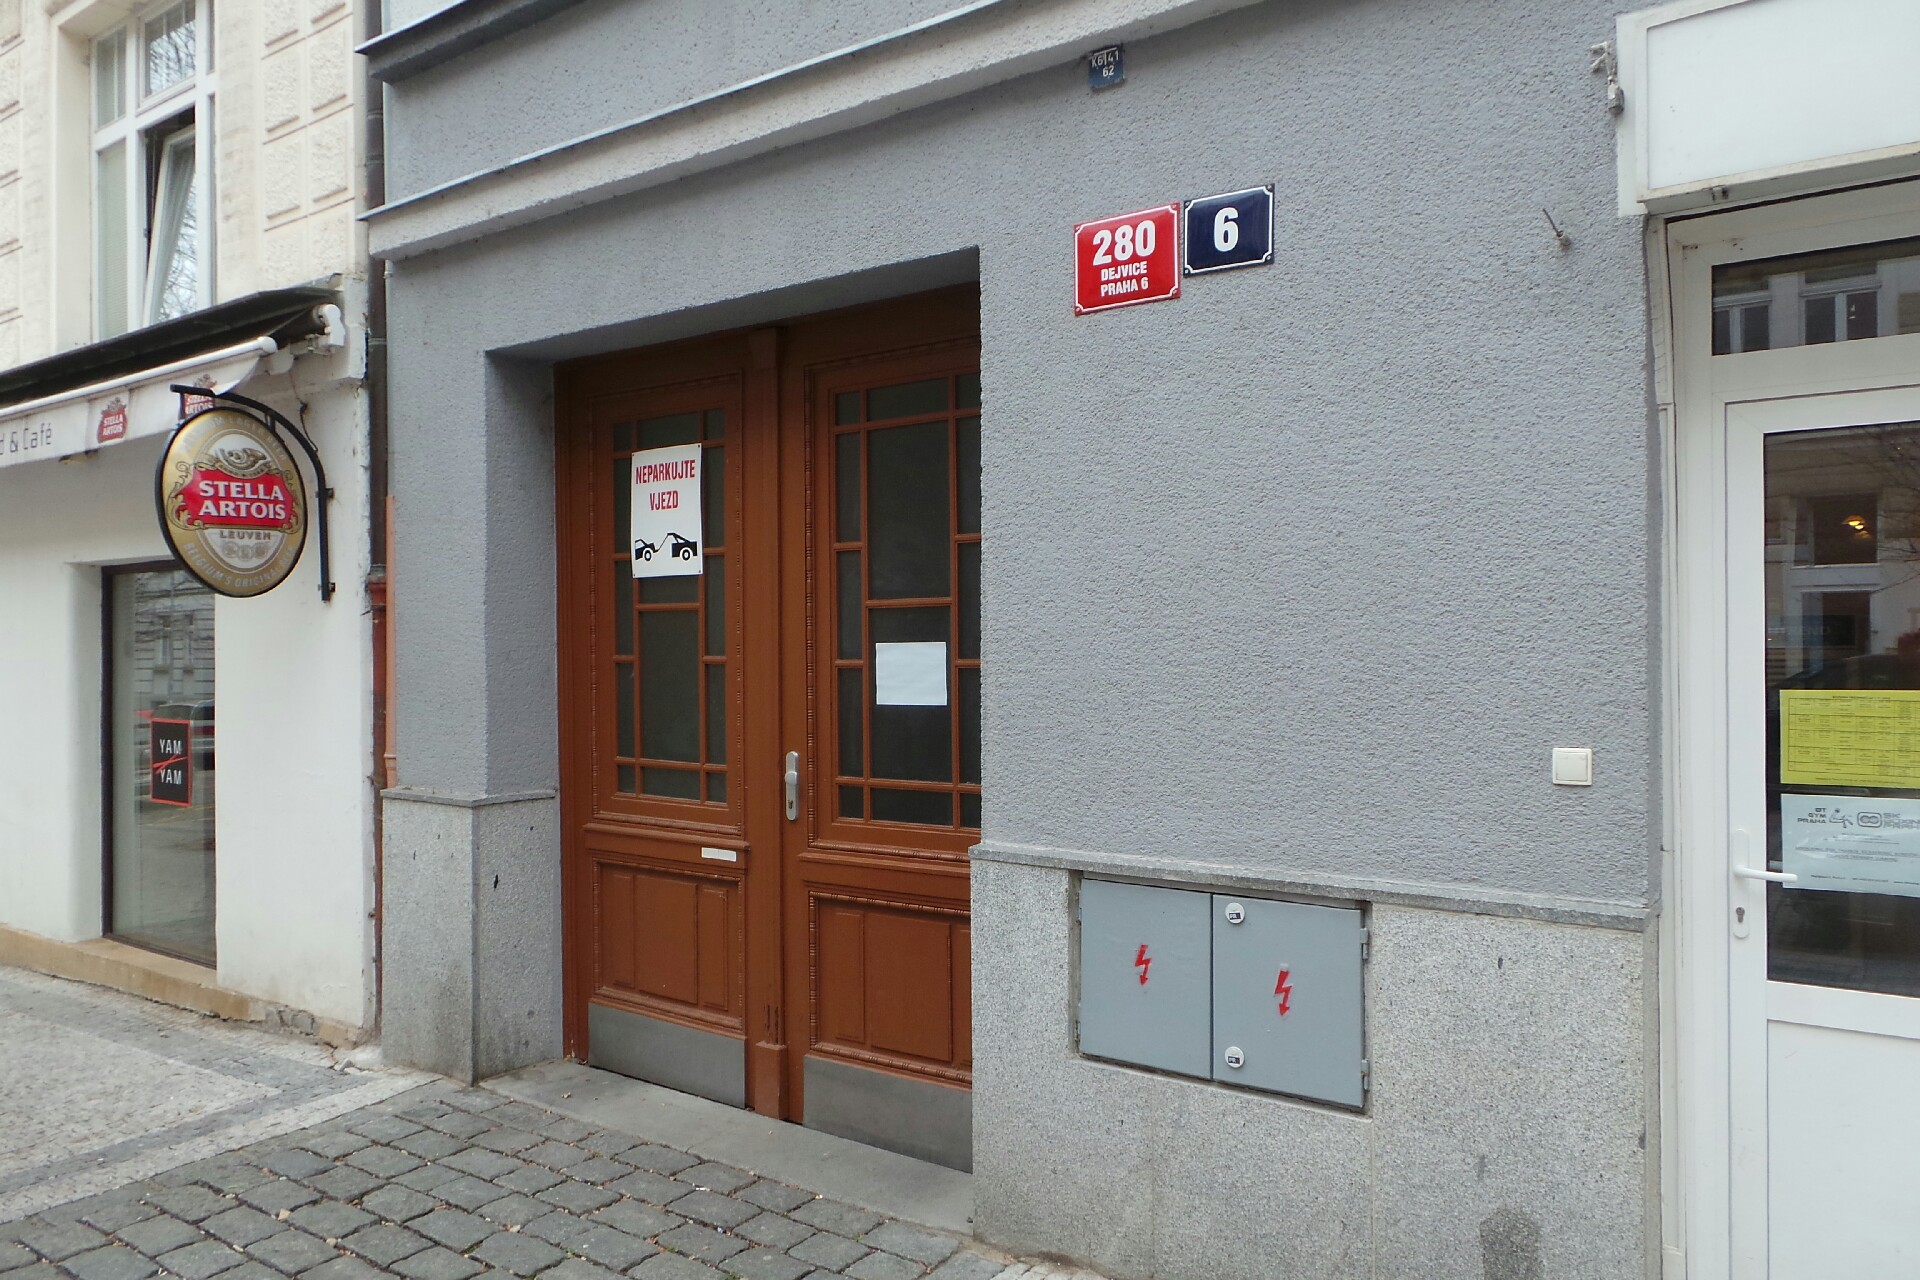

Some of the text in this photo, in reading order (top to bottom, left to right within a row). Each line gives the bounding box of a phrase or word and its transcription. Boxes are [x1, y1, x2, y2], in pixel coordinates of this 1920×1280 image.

[1102, 64, 1115, 77] 62
[1213, 206, 1239, 252] 6
[1092, 219, 1156, 266] 280
[1100, 260, 1148, 282] DEJVICE
[1100, 276, 1149, 297] PRAHA 6
[103, 414, 124, 425] STELLA
[10, 431, 19, 453] &
[635, 459, 696, 485] NEPARKUJTE
[199, 480, 285, 501] STELLA
[649, 490, 679, 511] VJEZD
[198, 500, 286, 520] ARTOIS
[219, 529, 272, 541] LEUVEN
[159, 738, 182, 755] YAM
[159, 769, 182, 785] YAM
